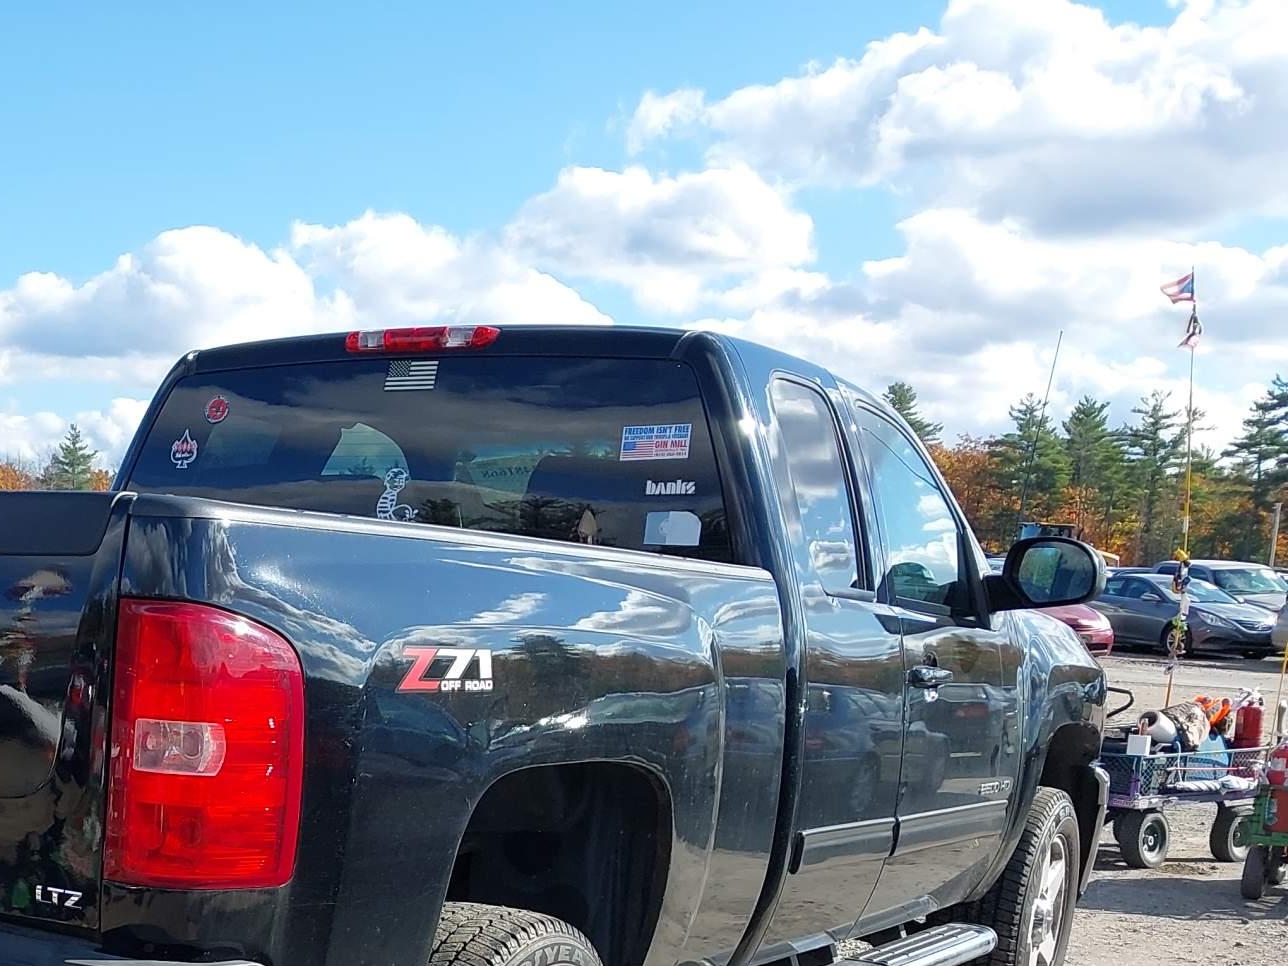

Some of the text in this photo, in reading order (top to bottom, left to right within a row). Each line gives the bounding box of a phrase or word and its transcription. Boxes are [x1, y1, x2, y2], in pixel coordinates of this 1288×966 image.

[625, 427, 654, 435] FREEDOM
[654, 440, 688, 449] GIN MILL
[397, 646, 492, 692] Z71
[441, 680, 494, 691] OFF ROAD
[35, 885, 83, 910] LTZ
